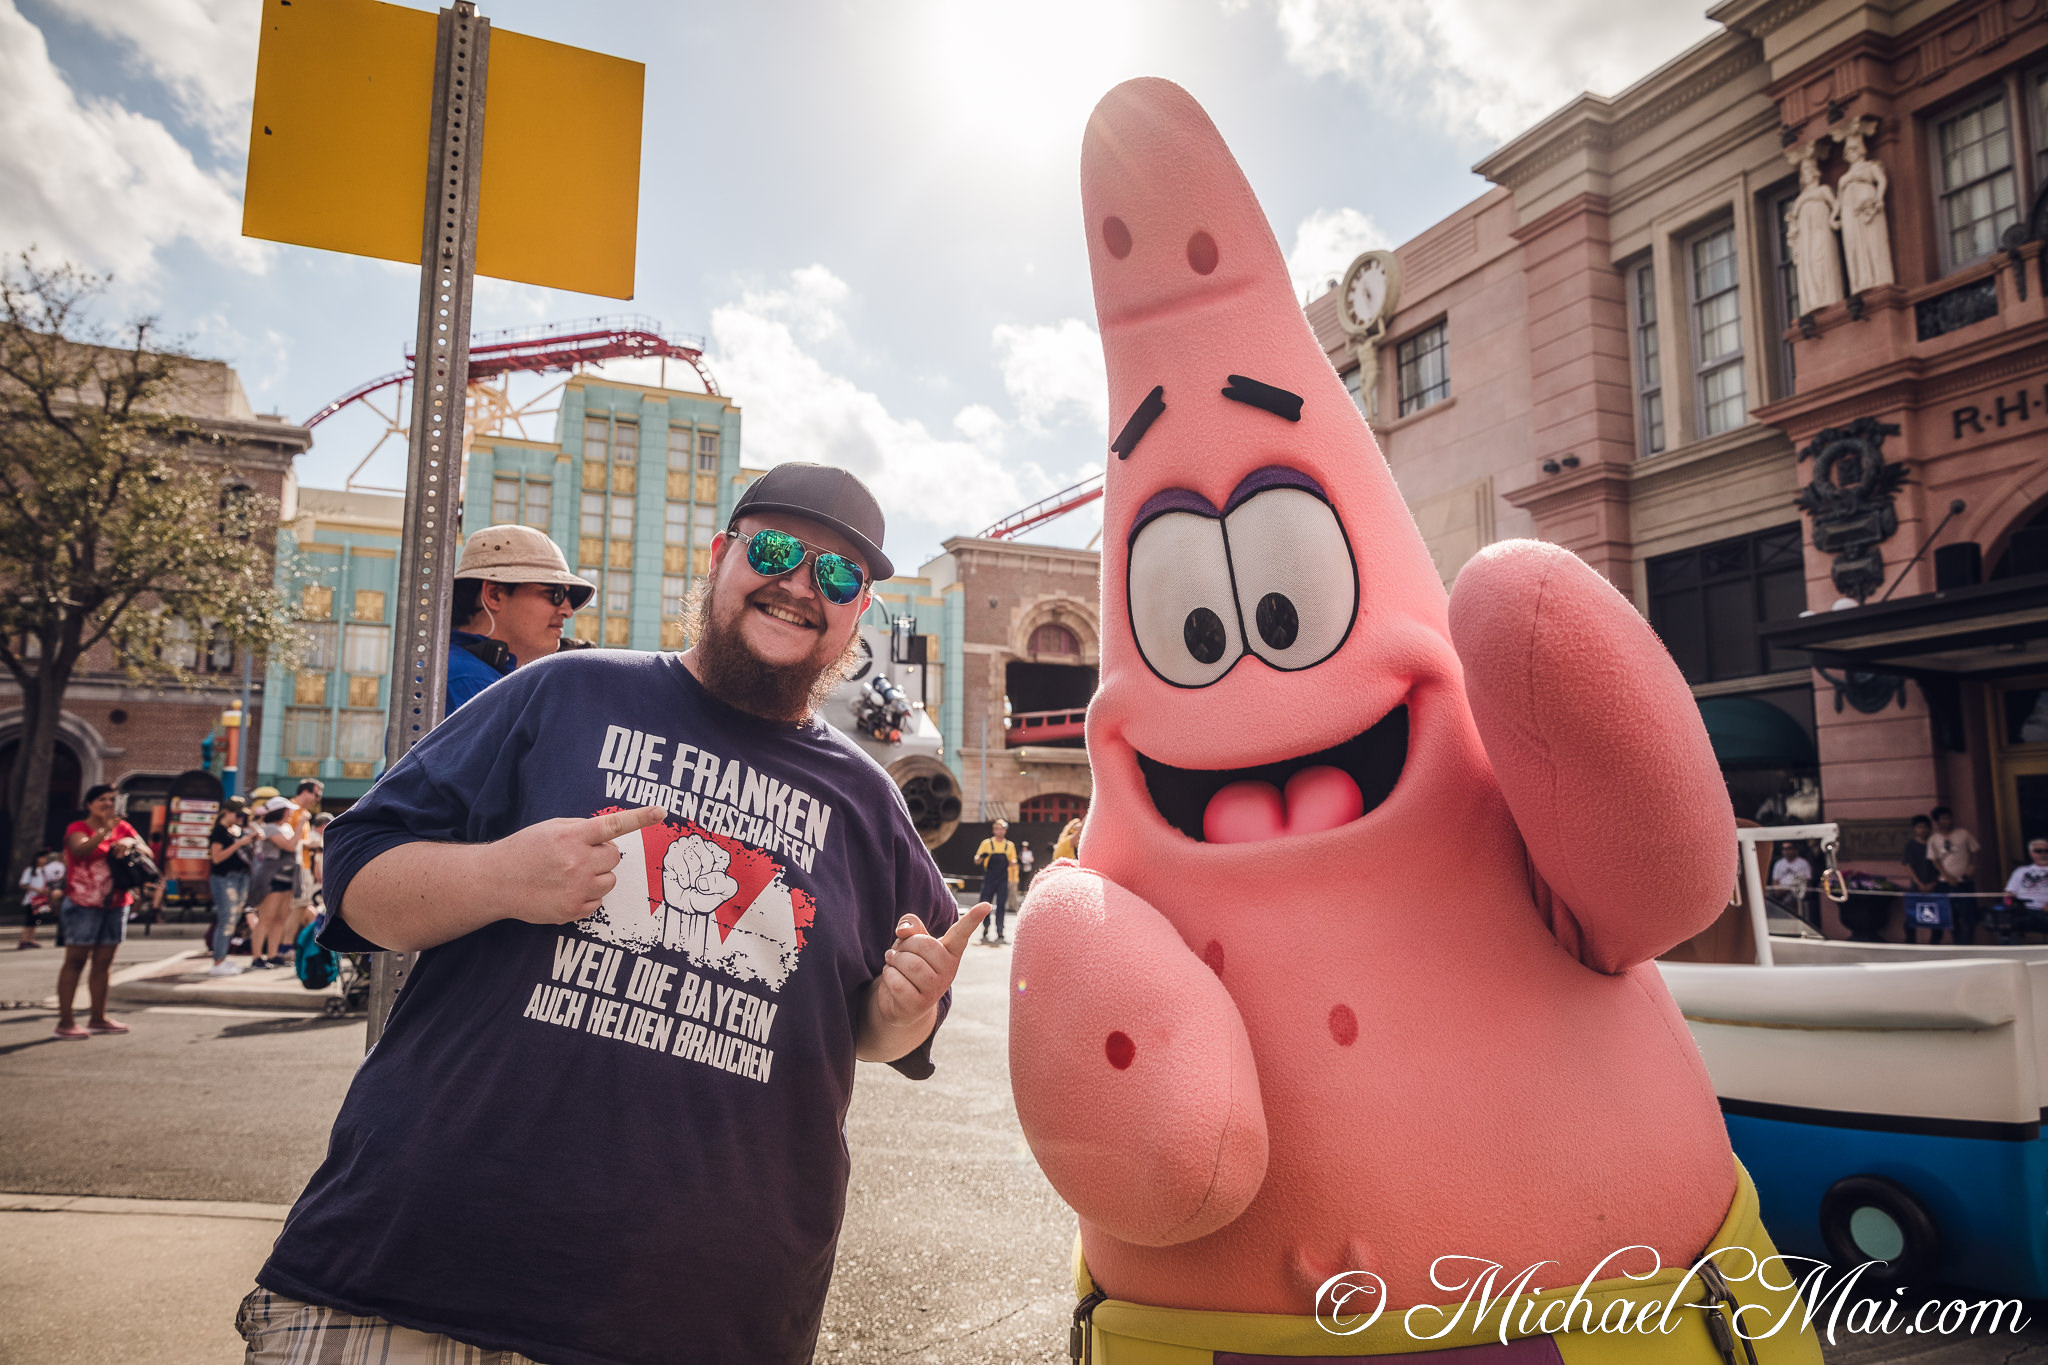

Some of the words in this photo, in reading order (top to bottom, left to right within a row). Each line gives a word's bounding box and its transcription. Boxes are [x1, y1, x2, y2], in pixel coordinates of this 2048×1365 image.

[597, 724, 667, 781] DIE
[670, 742, 832, 851] FRANKEN
[605, 771, 699, 822] WURDEN
[699, 798, 816, 874] ERSCHAFFEN
[523, 983, 587, 1030] AUCH
[585, 996, 675, 1053] HELDEN
[671, 1020, 774, 1084] BRAUCHEN
[551, 935, 624, 996] WEIL
[625, 955, 678, 1010] DIE
[675, 971, 778, 1045] BAYERN
